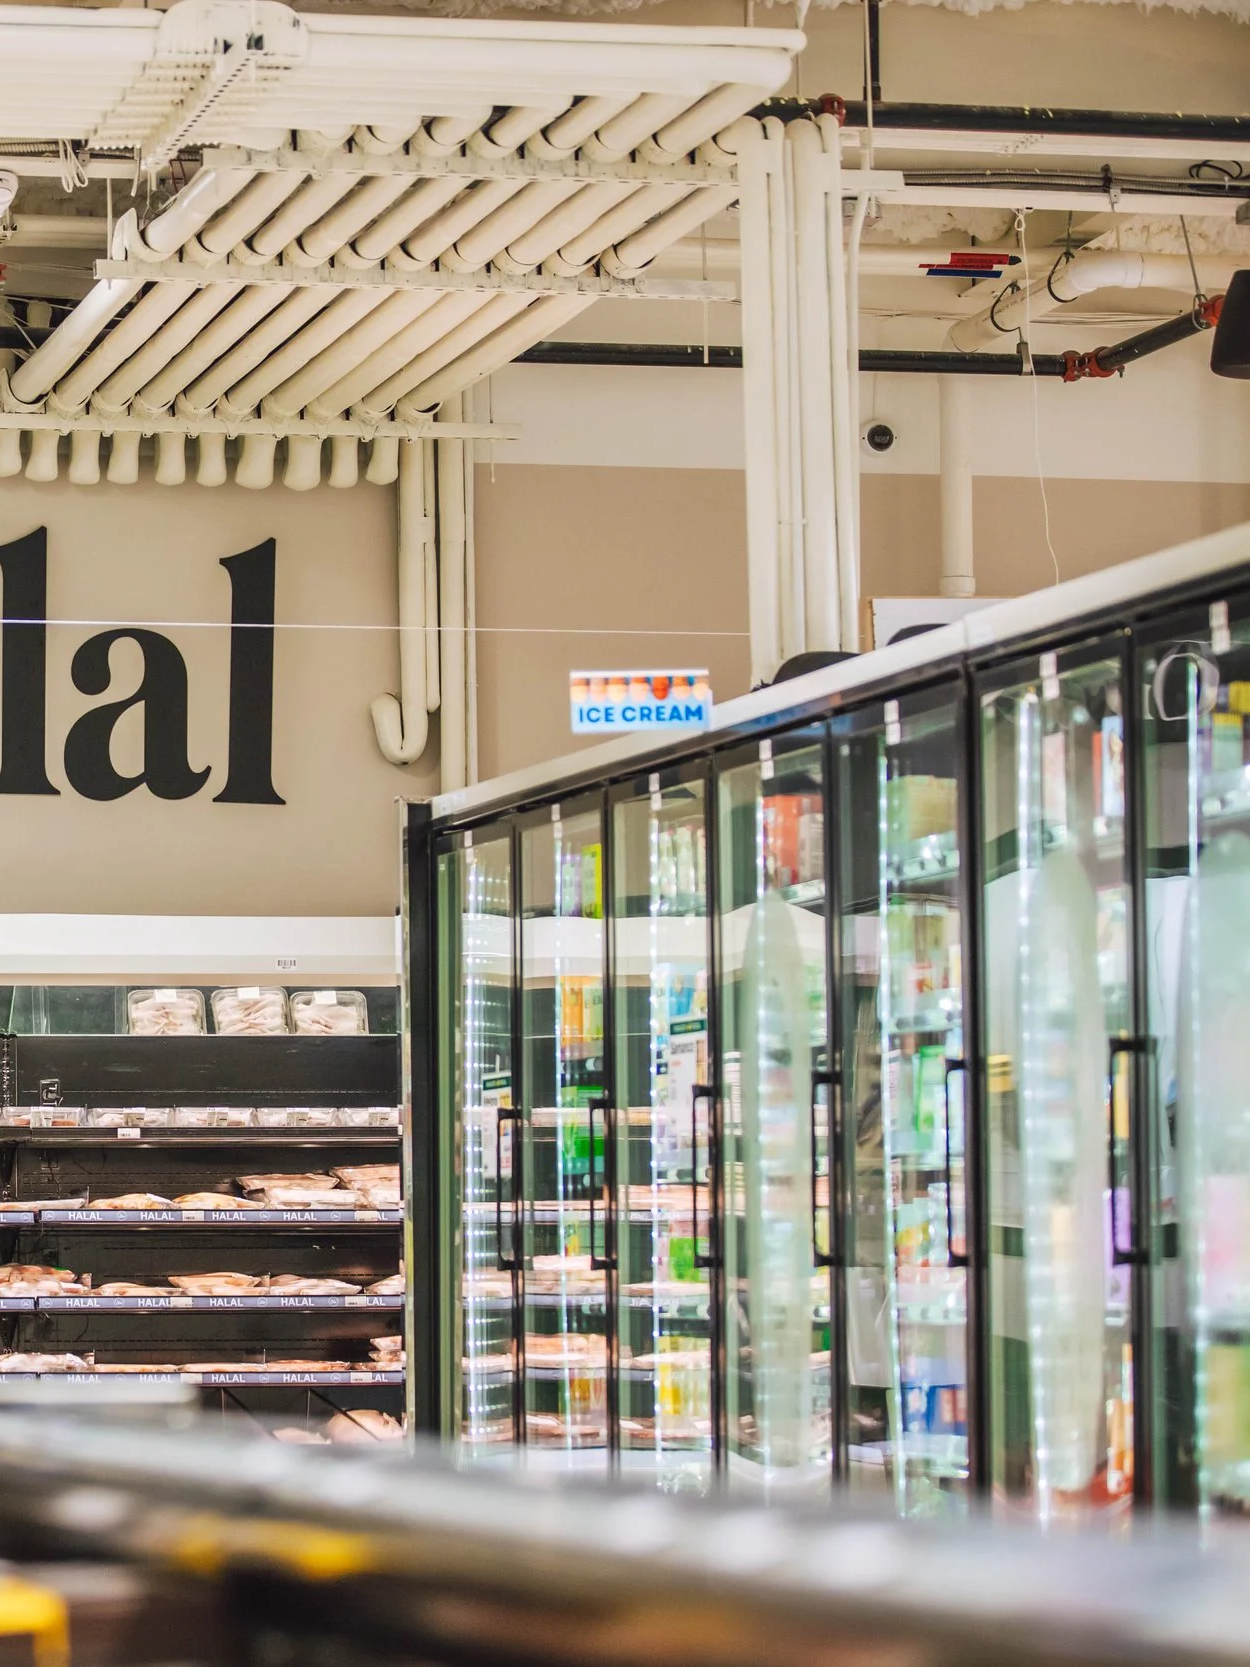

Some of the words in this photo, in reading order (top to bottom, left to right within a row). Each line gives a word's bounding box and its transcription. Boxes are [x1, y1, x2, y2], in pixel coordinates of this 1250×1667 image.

[578, 707, 615, 723] ICE
[621, 704, 704, 722] CREAM
[68, 1211, 103, 1221] HALAL
[140, 1211, 175, 1221] HALAL
[211, 1211, 247, 1221] HALAL
[283, 1211, 318, 1221] HALAL
[65, 1298, 100, 1307] HALAL
[209, 1297, 244, 1307] HALAL
[281, 1297, 315, 1307] HALAL
[367, 1297, 386, 1307] LAL
[67, 1374, 101, 1384] HALAL
[139, 1374, 174, 1384] HALAL
[211, 1373, 246, 1383] HALAL
[283, 1373, 317, 1383] HALAL
